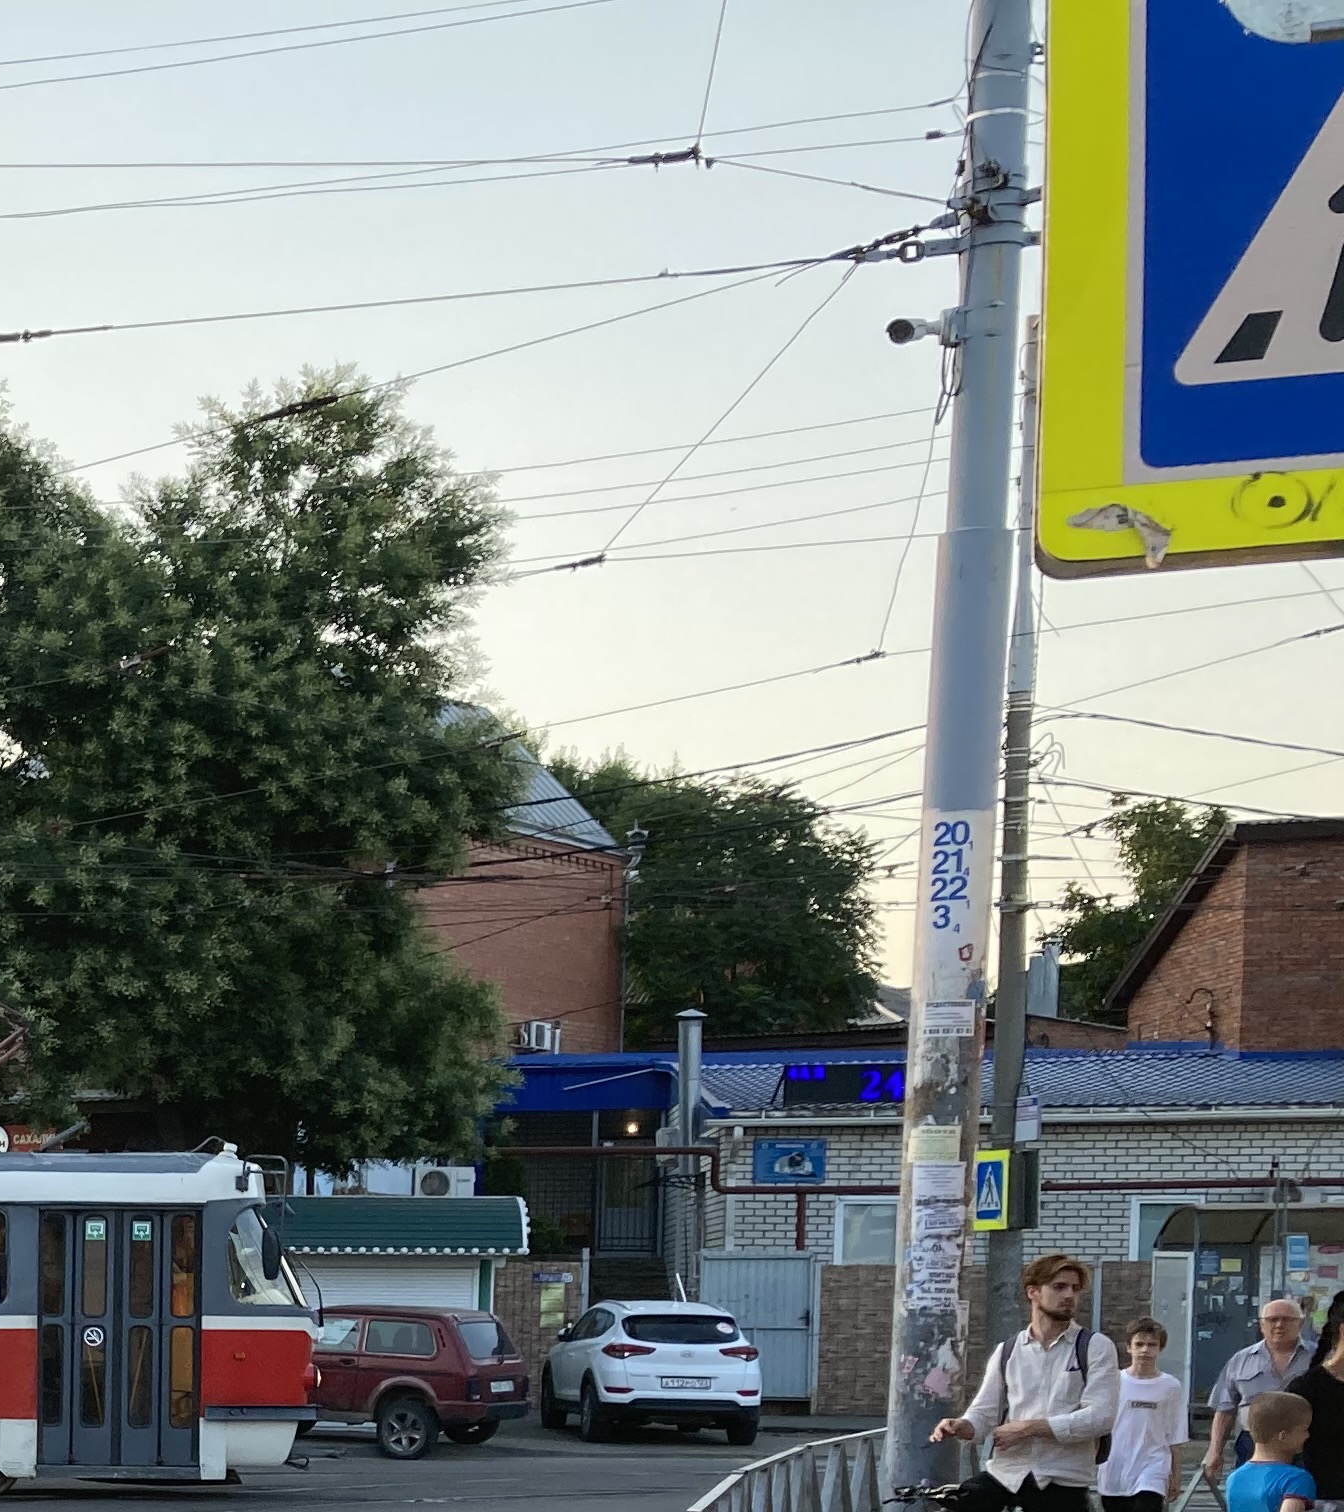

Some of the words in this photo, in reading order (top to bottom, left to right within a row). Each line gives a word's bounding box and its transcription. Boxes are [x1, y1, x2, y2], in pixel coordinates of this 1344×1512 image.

[934, 821, 970, 847] 20
[932, 849, 963, 875] 21
[930, 876, 968, 902] 22
[932, 904, 951, 929] 3
